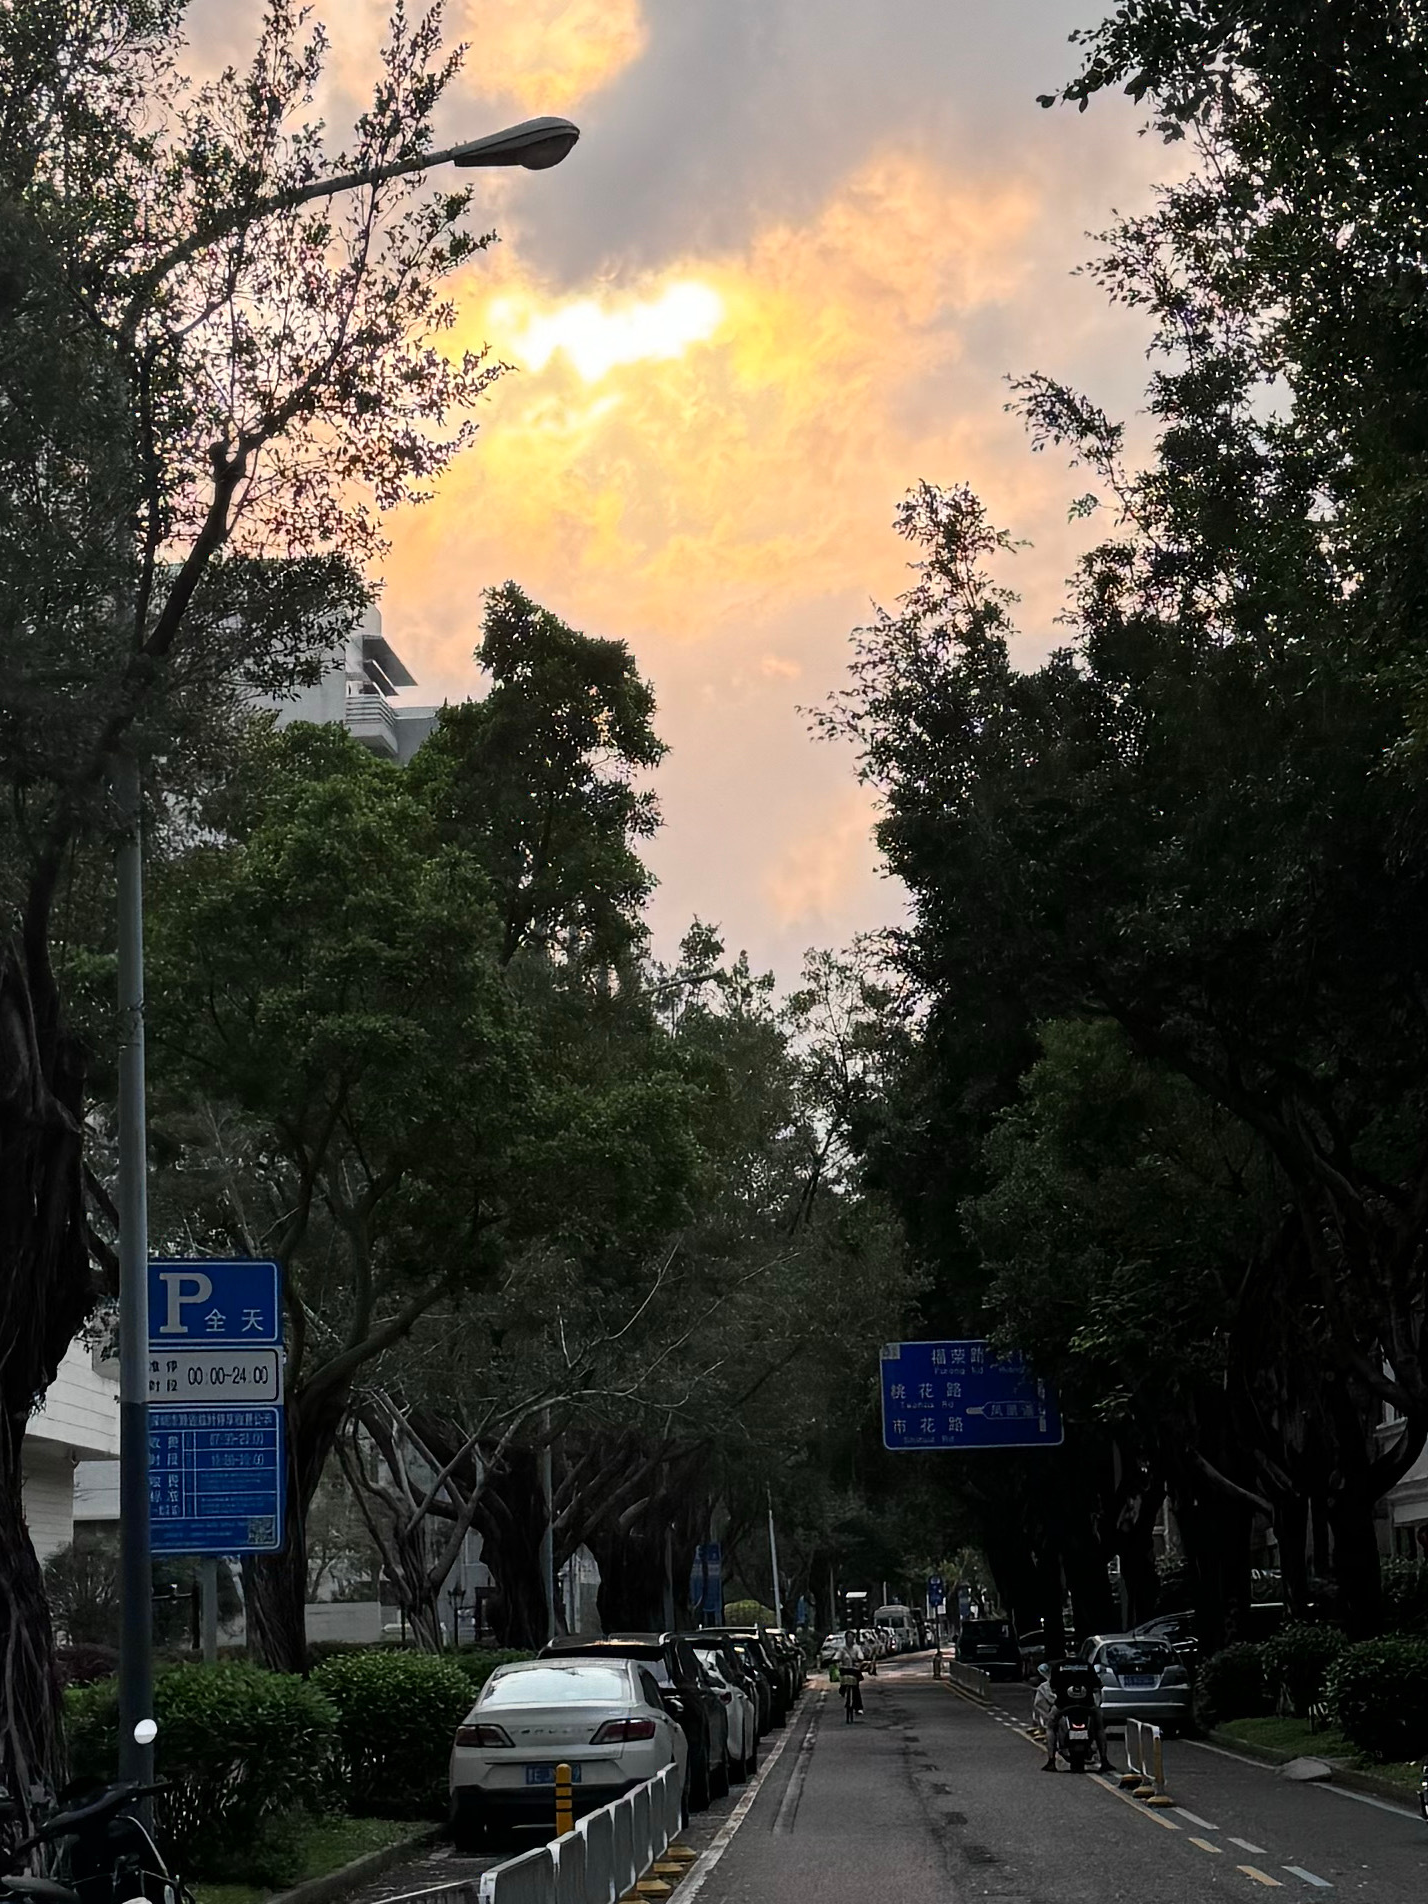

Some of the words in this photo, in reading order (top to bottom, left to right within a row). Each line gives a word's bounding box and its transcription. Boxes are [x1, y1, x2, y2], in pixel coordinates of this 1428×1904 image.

[159, 1272, 213, 1334] P
[203, 1308, 264, 1333] 全天
[890, 1382, 962, 1399] 桃花路
